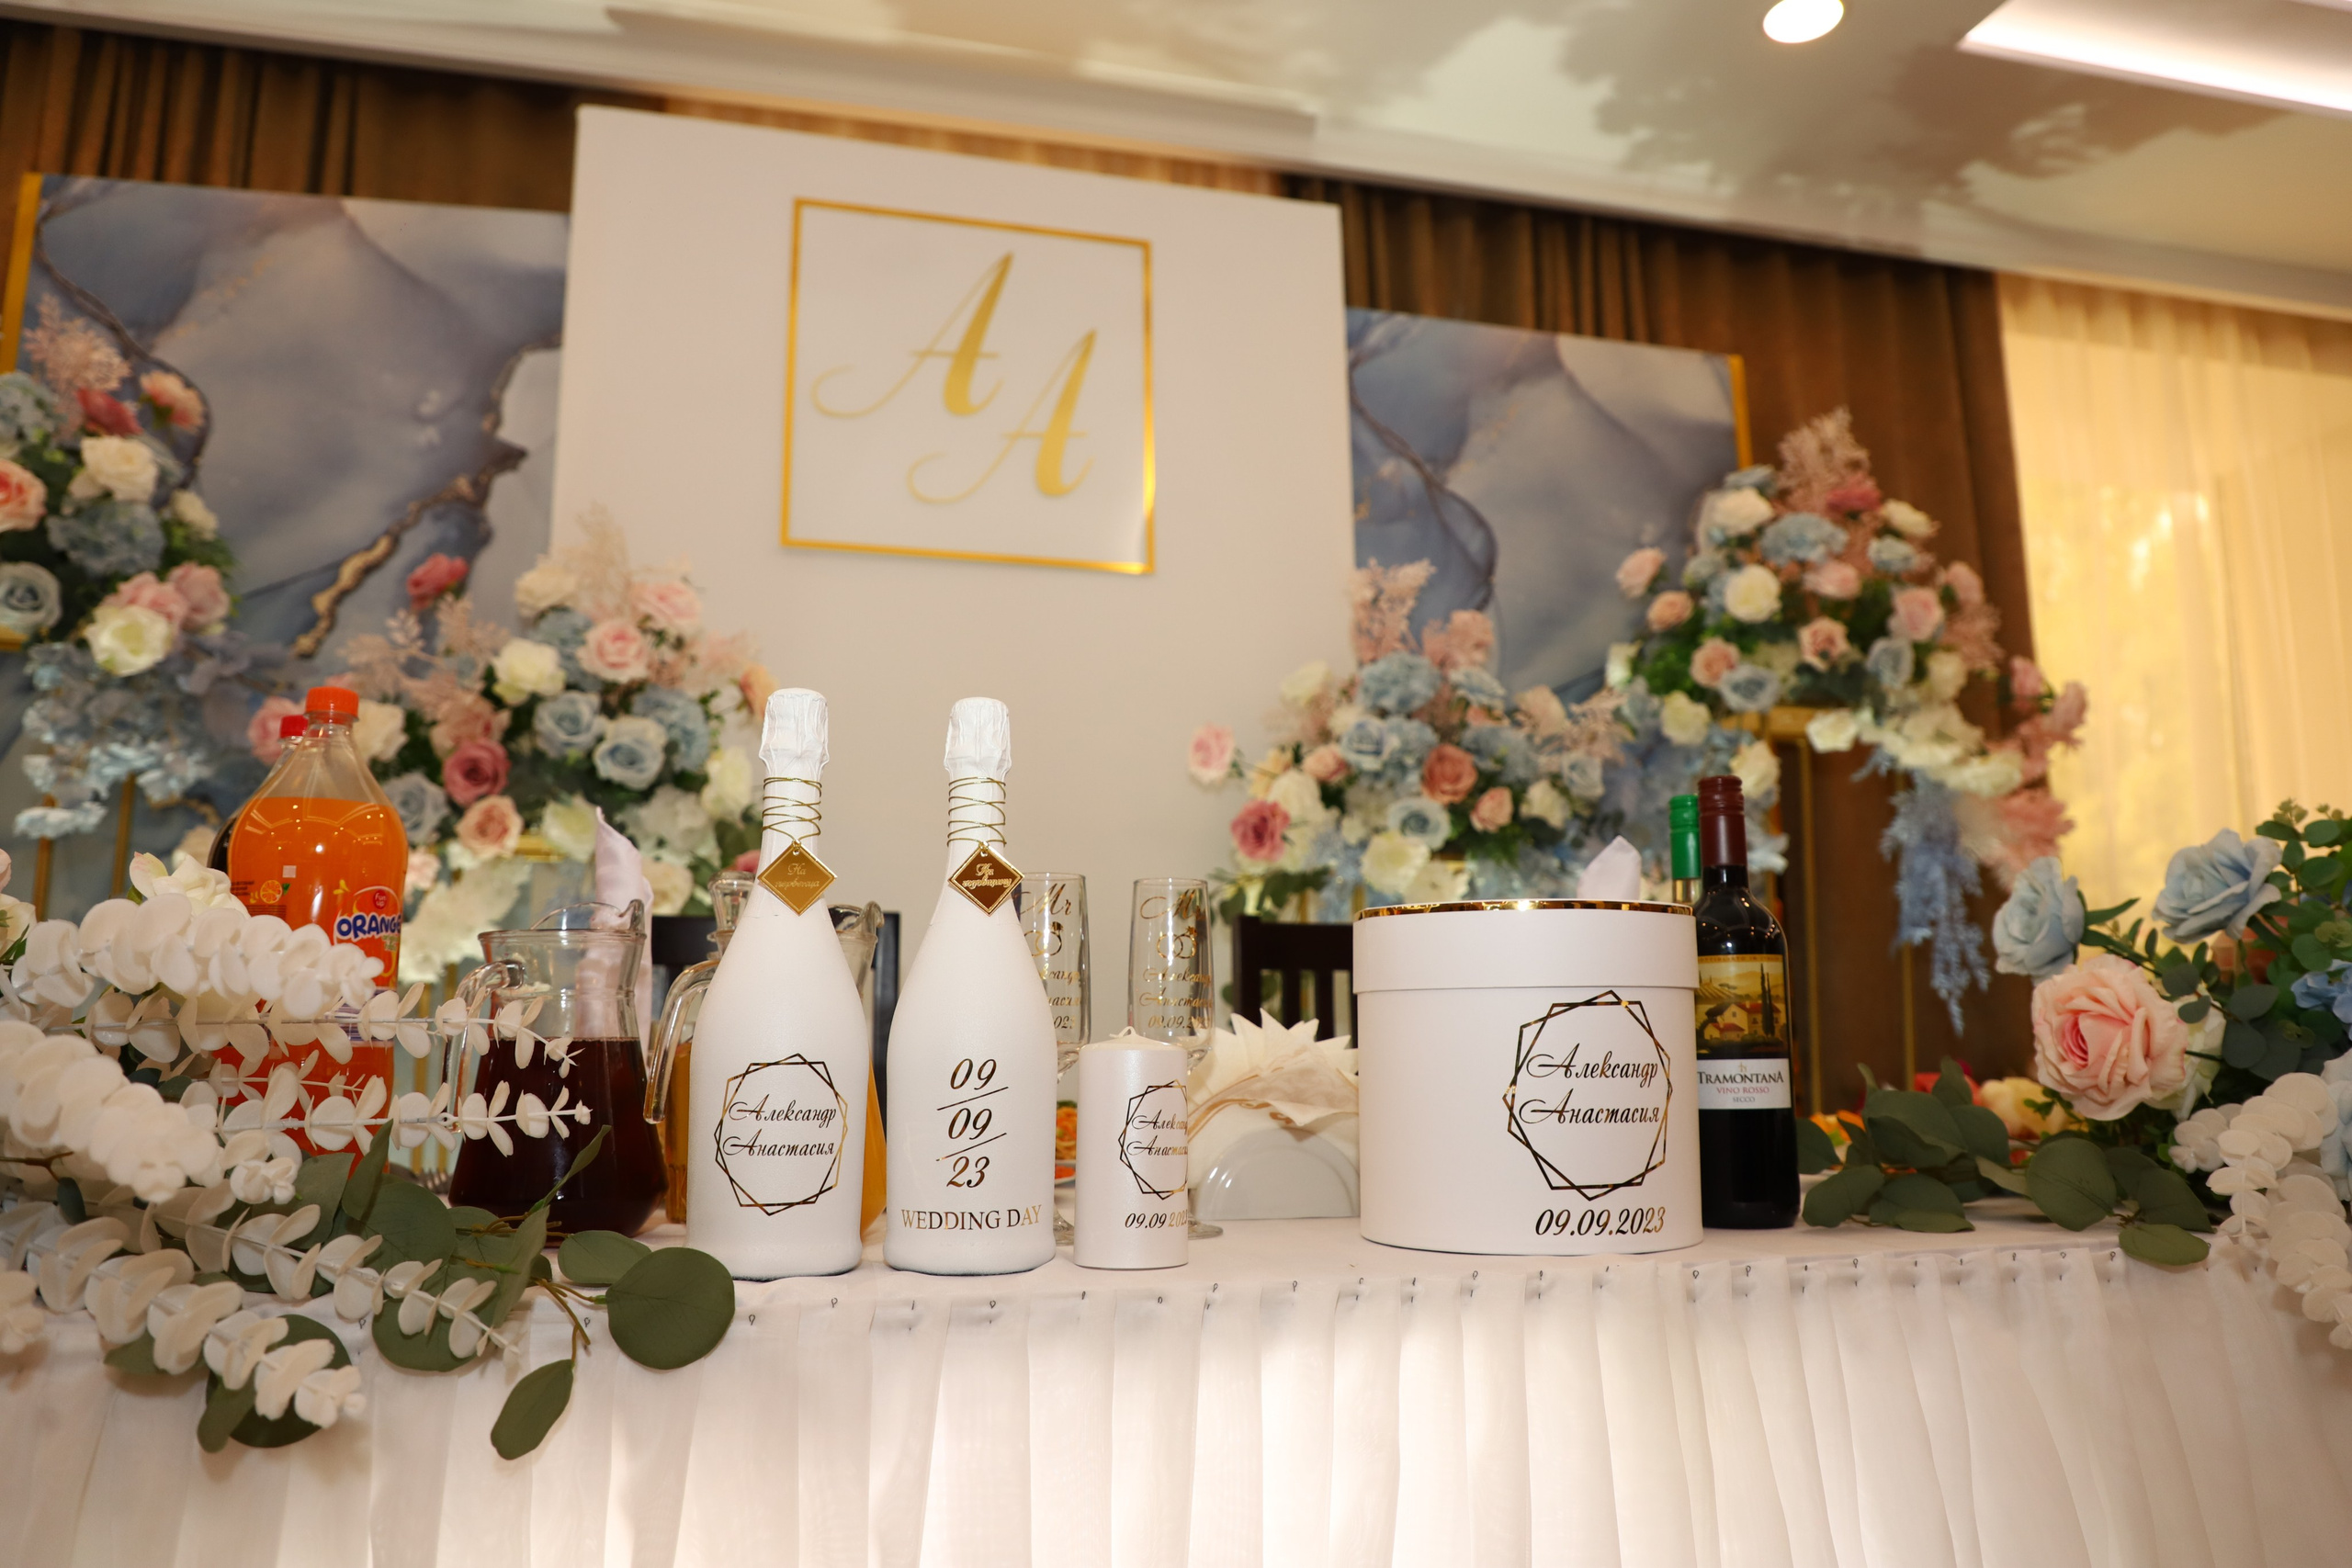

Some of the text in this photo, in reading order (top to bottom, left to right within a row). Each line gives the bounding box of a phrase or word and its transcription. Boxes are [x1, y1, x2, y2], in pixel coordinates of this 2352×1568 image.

[1012, 883, 1071, 916] Mr
[949, 1058, 997, 1090] 09
[1526, 1043, 1658, 1088] Александр
[1697, 1070, 1784, 1084] TRAMONTANA
[729, 1093, 836, 1129] Александр
[1518, 1088, 1660, 1124] Анастасия
[947, 1108, 992, 1140] 09
[723, 1128, 834, 1156] Анастасия
[945, 1156, 990, 1189] 23
[900, 1204, 1042, 1231] WEDDING DAY
[1535, 1206, 1667, 1236] 09.09.2023
